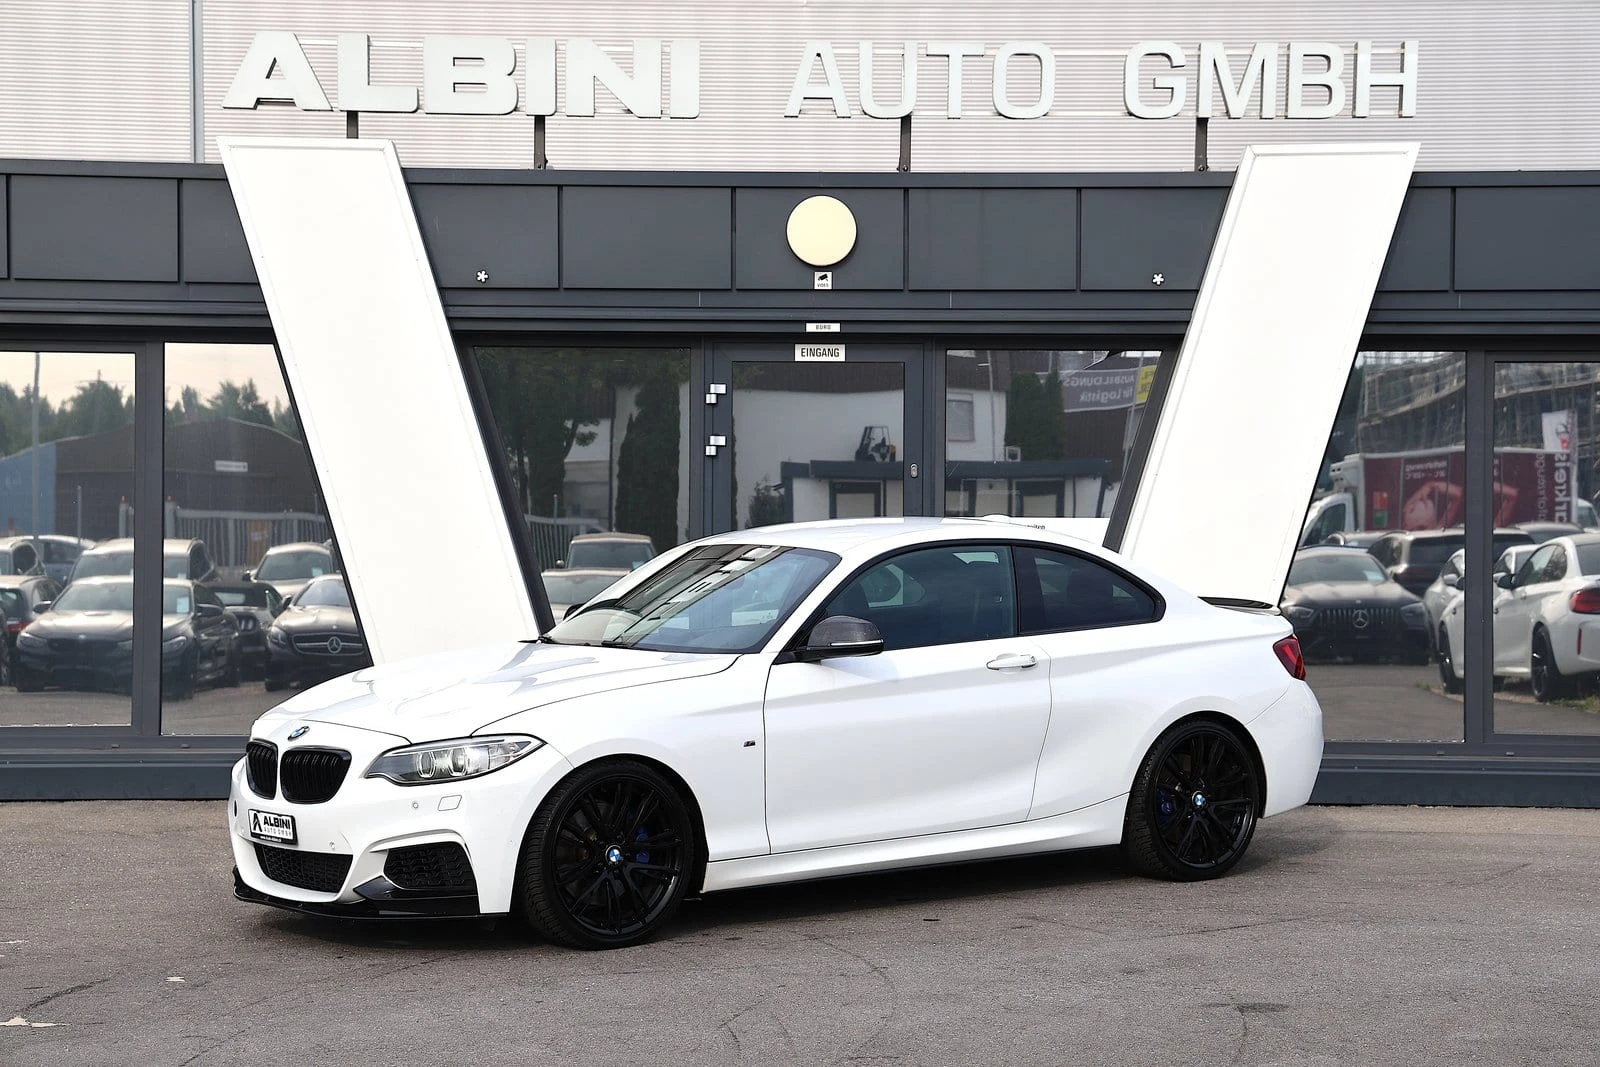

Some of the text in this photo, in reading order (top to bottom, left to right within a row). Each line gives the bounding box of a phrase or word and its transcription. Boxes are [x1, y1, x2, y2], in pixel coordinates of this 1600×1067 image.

[221, 32, 1420, 119] ALBINI AUTO GMBH
[800, 347, 840, 358] EINGANG
[264, 816, 291, 829] ALBINI
